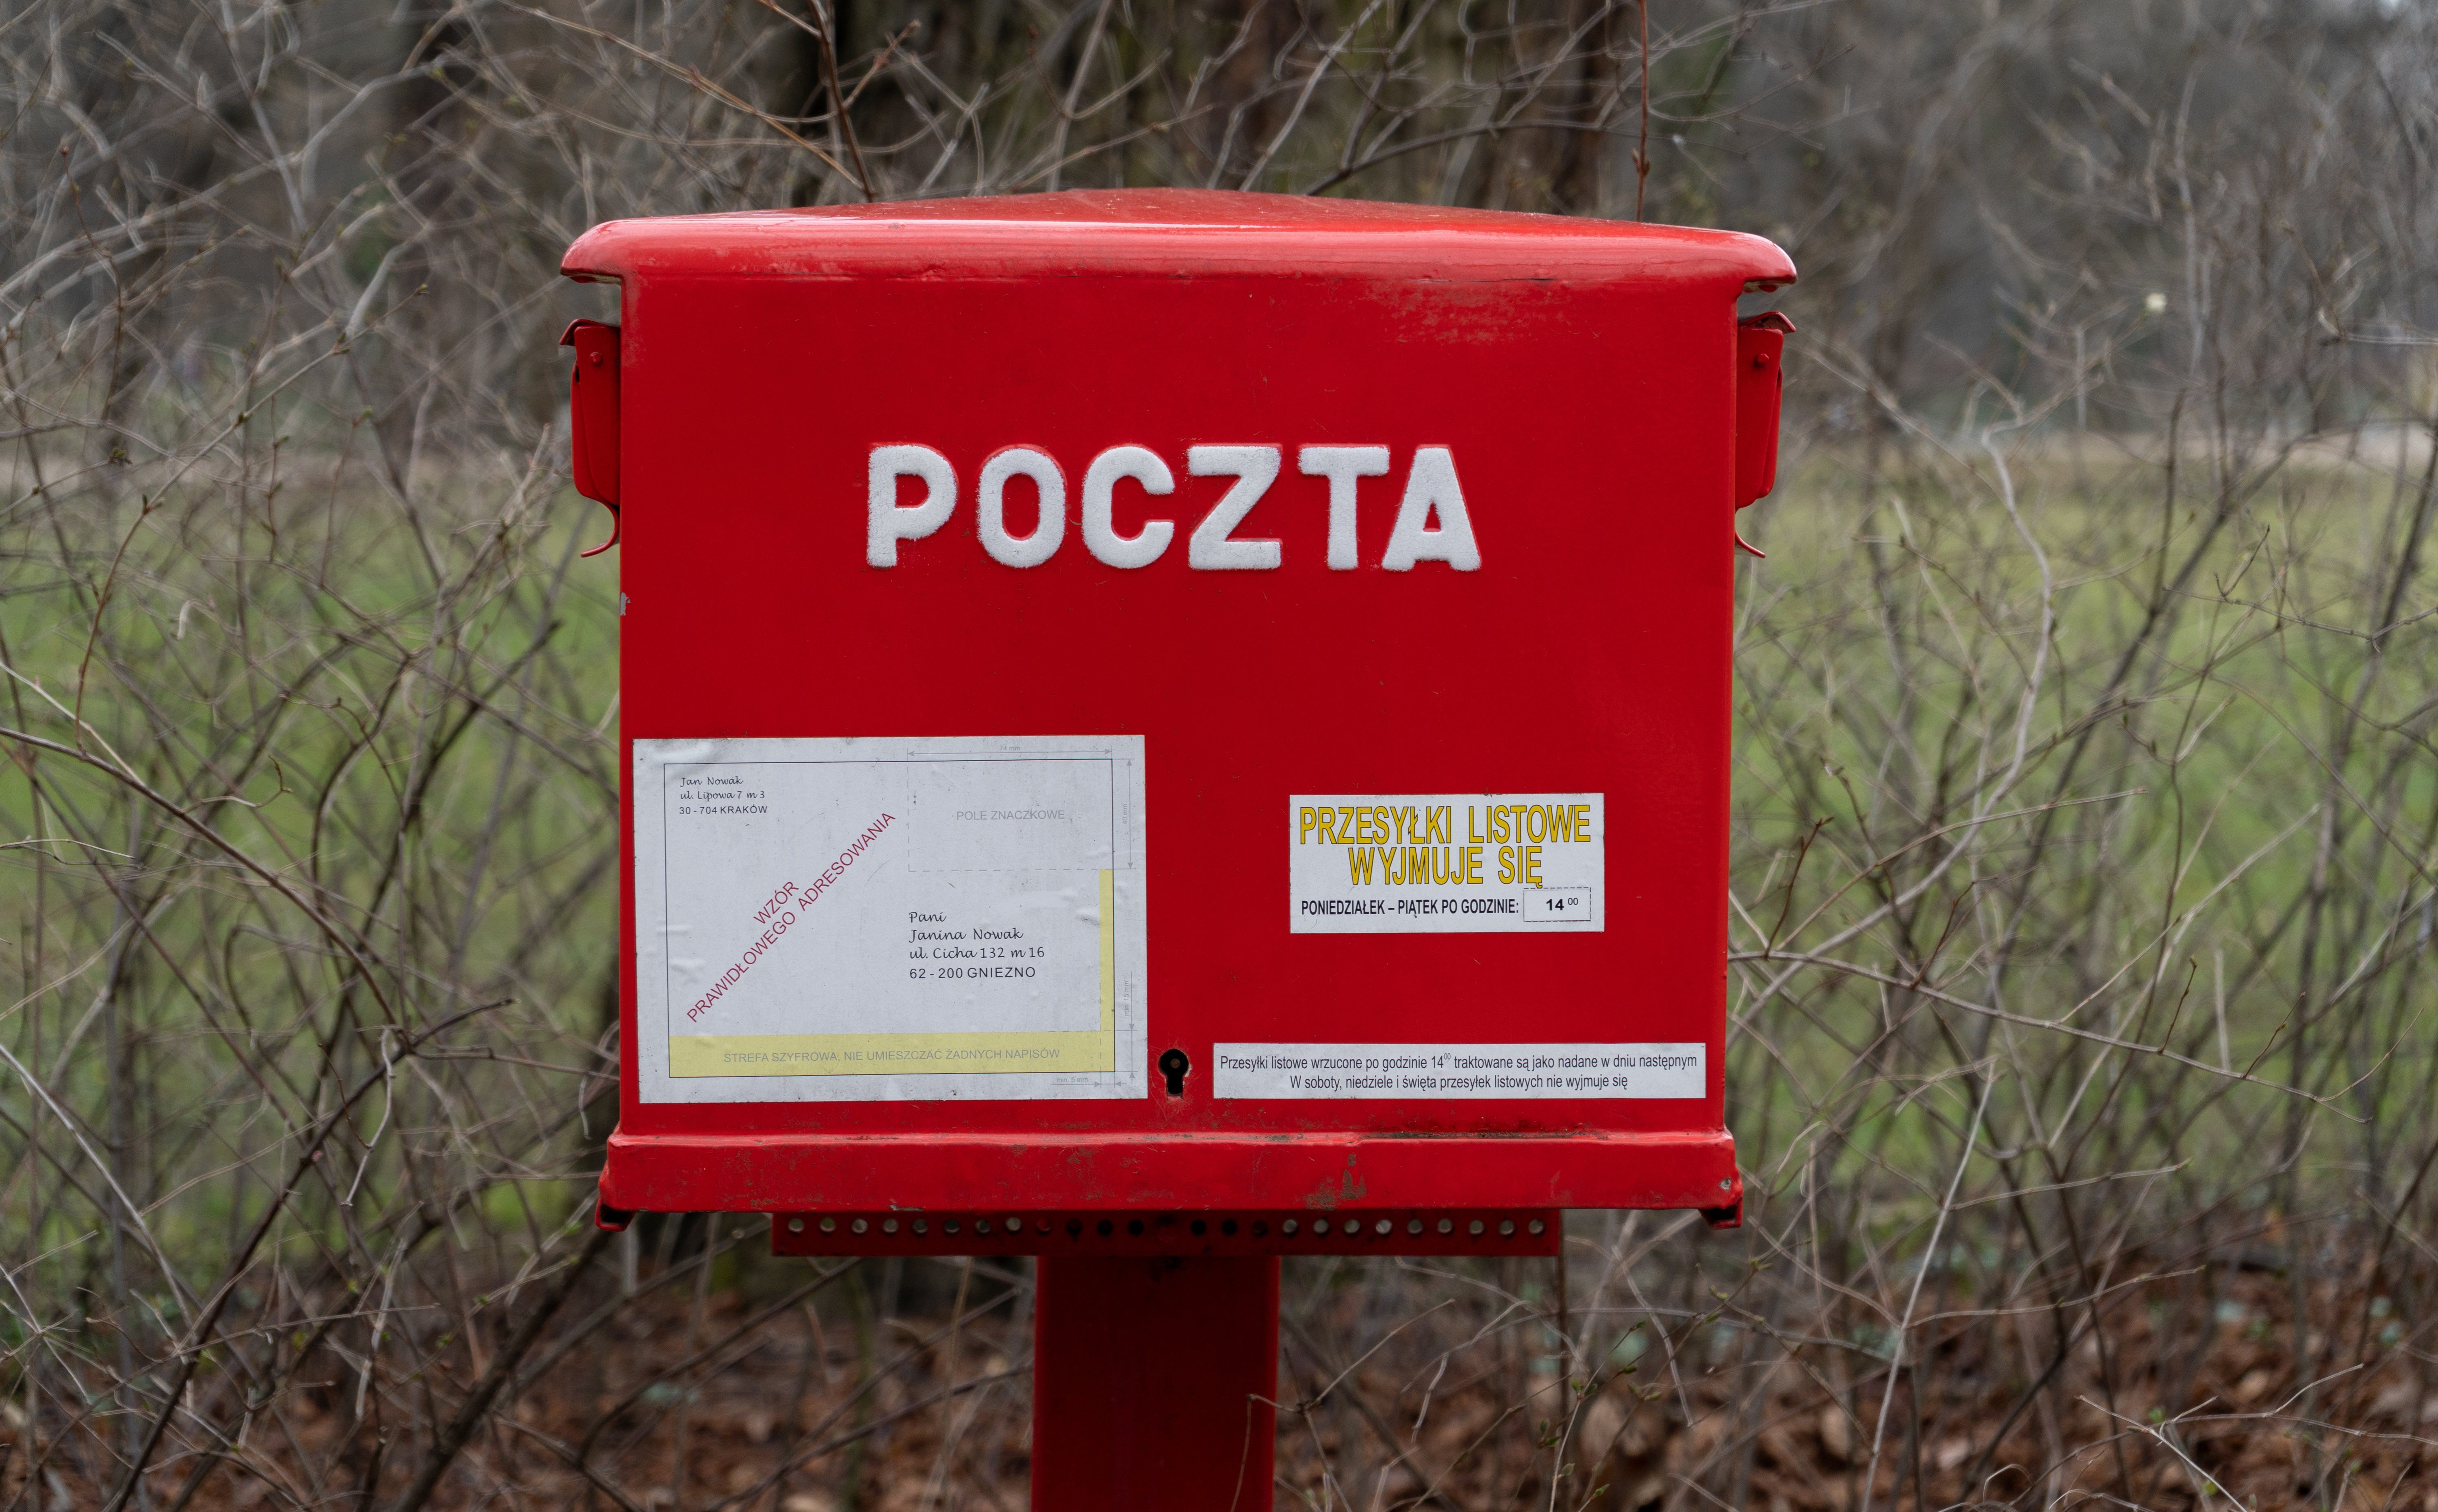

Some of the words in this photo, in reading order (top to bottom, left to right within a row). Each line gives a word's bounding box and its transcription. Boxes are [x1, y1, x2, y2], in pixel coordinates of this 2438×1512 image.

[866, 443, 1481, 572] POCZTA
[680, 777, 703, 787] Jan
[707, 776, 744, 785] Nowak
[680, 791, 694, 799] ul.
[698, 791, 735, 802] Lipowa
[737, 791, 742, 799] 7
[760, 790, 765, 798] 3
[720, 804, 768, 814] KRAKÓW
[957, 811, 987, 820] POLE
[991, 810, 1065, 820] ZNACZKOWE
[1123, 804, 1128, 815] mm
[1300, 806, 1451, 844] PRZESYŁKI
[1468, 805, 1590, 843] LISTOWE
[1348, 847, 1483, 885] WYJMUJE
[1498, 846, 1543, 889] SIĘ
[753, 881, 799, 925] WZÓR
[1301, 900, 1385, 915] PONIEDZIAŁEK
[1398, 900, 1438, 918] PIĄTEK
[1442, 899, 1458, 914] PO
[1461, 899, 1518, 914] GODZINIE:
[687, 911, 795, 1023] PRAWIDŁOWEGO
[798, 813, 896, 911] ADRESOWANIA
[909, 911, 947, 923] Pani
[909, 929, 967, 943] Janina
[973, 927, 1024, 939] Nowak
[910, 947, 928, 959] ul.
[933, 946, 977, 959] Cicha
[980, 947, 1005, 958] 132
[1011, 949, 1026, 958] m
[1029, 947, 1044, 958] 16
[967, 967, 1035, 978] GNIEZNO
[1124, 981, 1129, 992] mm
[724, 1052, 769, 1063] STREFA
[772, 1051, 840, 1063] SZYFROWA,
[844, 1051, 863, 1061] NIE
[867, 1049, 942, 1061] UMIESZCZAĆ
[946, 1048, 1002, 1060] ŻADNYCH
[1005, 1047, 1060, 1059] NAPISÓW
[1221, 1056, 1268, 1074] Przesyłki
[1271, 1056, 1308, 1069] listowe
[1311, 1058, 1362, 1069] wrzucone
[1366, 1059, 1379, 1074] po
[1382, 1055, 1427, 1075] godzinie
[1454, 1056, 1513, 1069] traktowane
[1516, 1059, 1529, 1071] są
[1531, 1055, 1554, 1071] jako
[1558, 1055, 1598, 1068] nadane
[1601, 1057, 1610, 1068] w
[1613, 1054, 1635, 1068] dniu
[1639, 1055, 1697, 1071] następnym
[1291, 1076, 1301, 1089] W
[1305, 1075, 1342, 1091] soboty,
[1346, 1075, 1393, 1089] niedziele
[1397, 1075, 1399, 1088] i
[1403, 1075, 1436, 1091] święta
[1440, 1075, 1491, 1092] przesyłek
[1494, 1075, 1542, 1091] listowych
[1547, 1075, 1562, 1088] nie
[1566, 1075, 1609, 1091] wyjmuje
[1613, 1074, 1628, 1090] się
